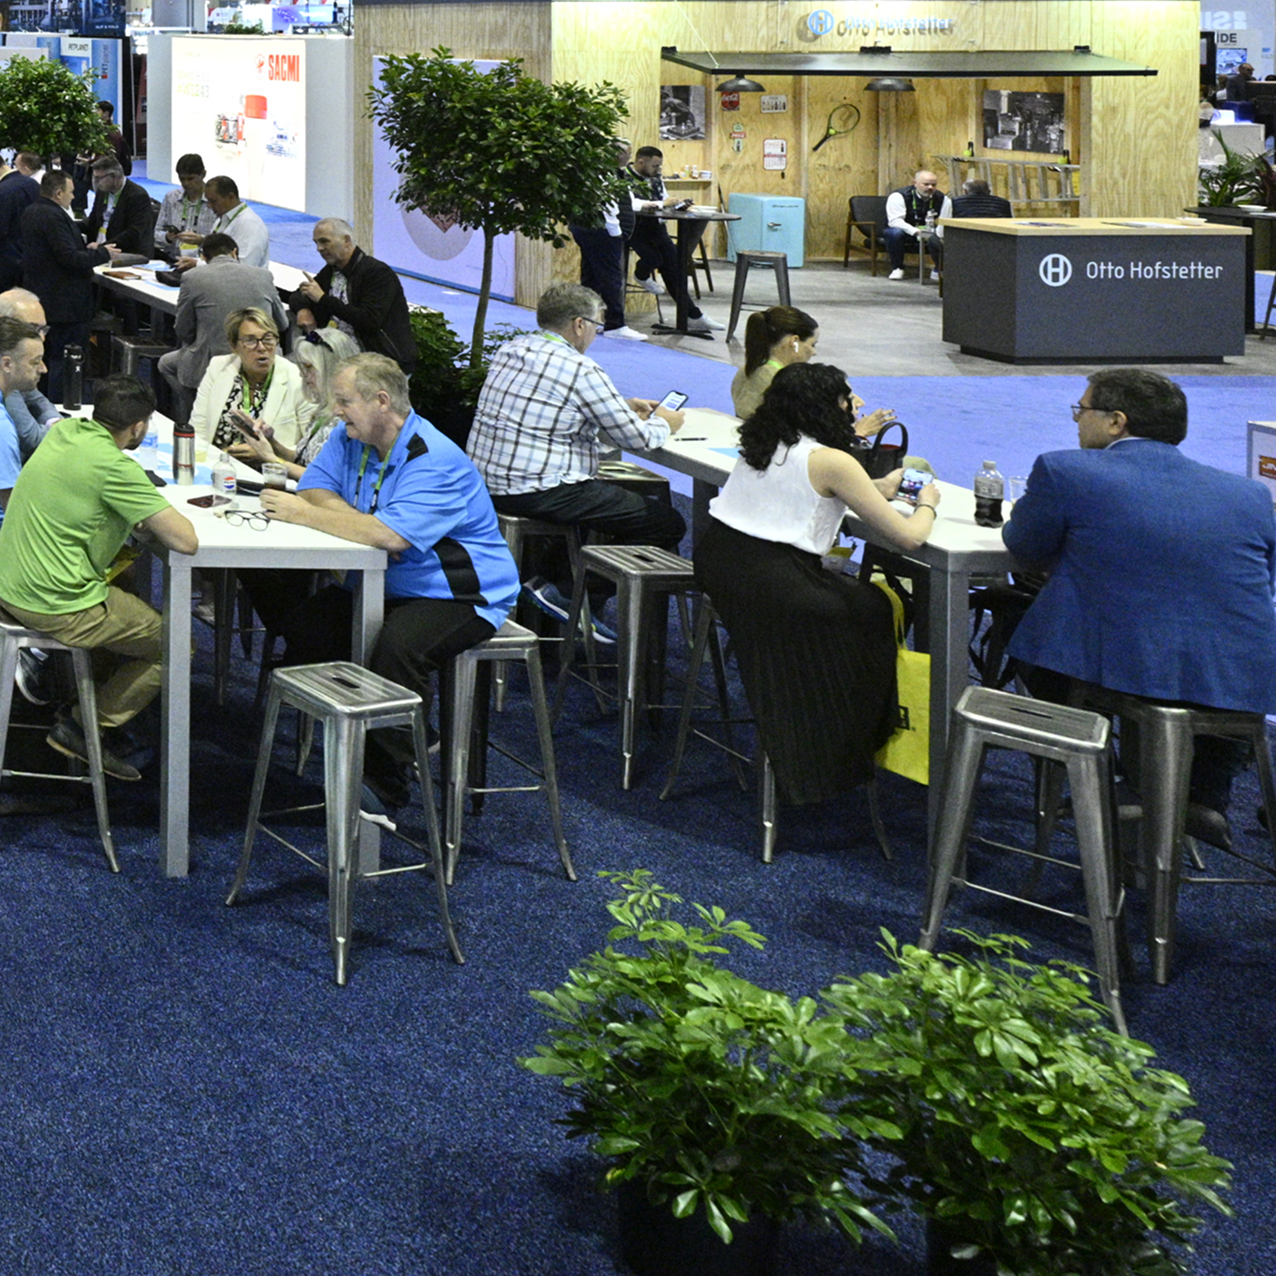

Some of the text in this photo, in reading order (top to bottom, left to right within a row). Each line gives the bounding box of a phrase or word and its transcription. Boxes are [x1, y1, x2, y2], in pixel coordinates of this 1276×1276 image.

[878, 15, 953, 29] Hofstetter
[1216, 32, 1238, 43] IDE
[268, 54, 300, 82] SACMI
[1086, 261, 1223, 279] Otto Hofstetter
